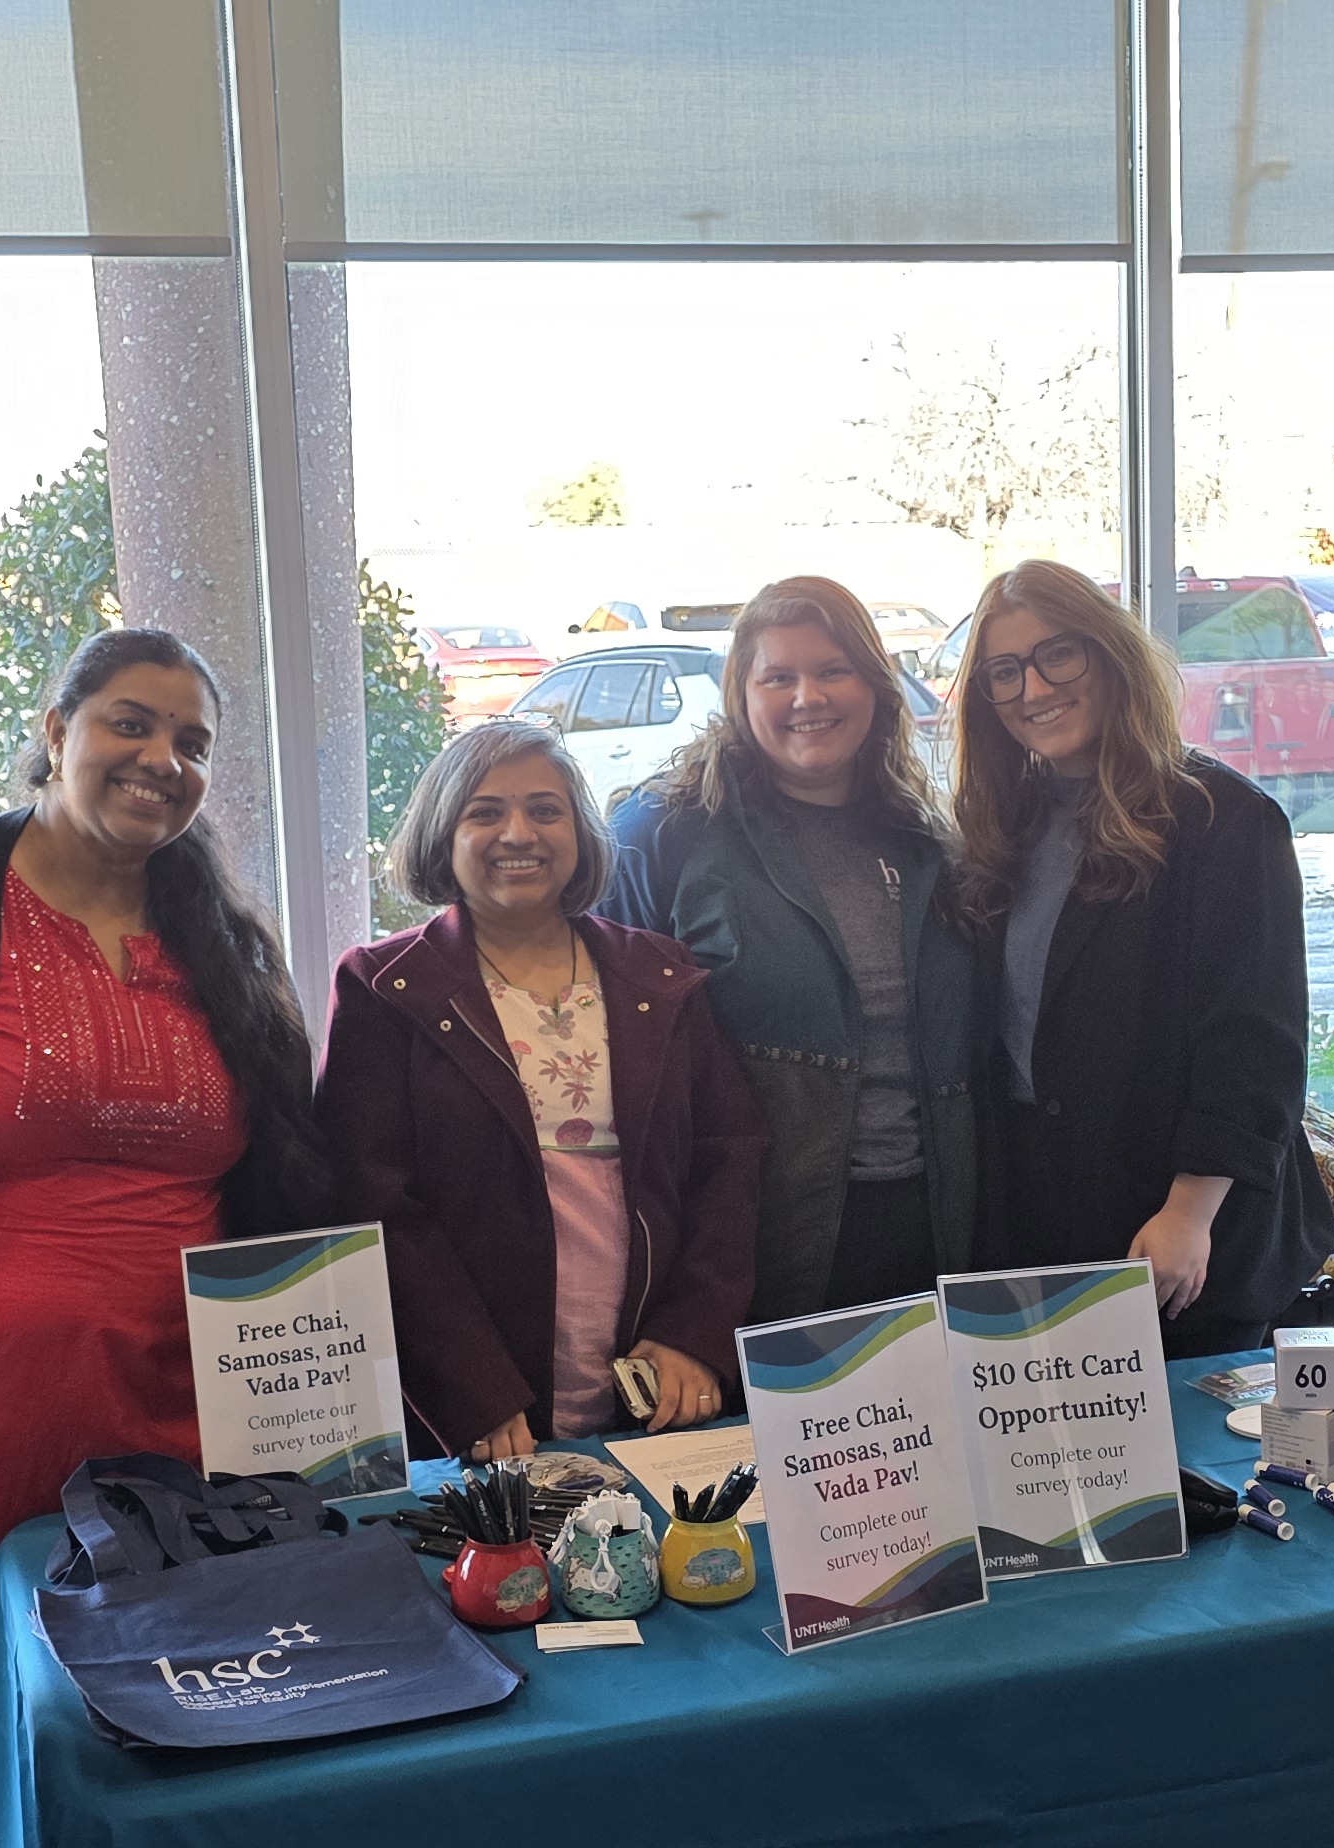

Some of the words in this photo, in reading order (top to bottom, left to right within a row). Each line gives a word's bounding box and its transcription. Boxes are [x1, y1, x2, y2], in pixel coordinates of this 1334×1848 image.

[237, 1322, 286, 1344] Free
[293, 1309, 349, 1336] Chai,
[218, 1345, 320, 1374] Samosas,
[327, 1333, 367, 1358] and
[972, 1361, 1016, 1392] $10
[1023, 1356, 1076, 1384] Gift
[1081, 1349, 1143, 1377] Card
[246, 1371, 300, 1397] Vada
[306, 1364, 351, 1389] Pav!
[1295, 1364, 1327, 1389] 60
[248, 1404, 326, 1431] Complete
[330, 1401, 357, 1419] our
[800, 1415, 851, 1441] Free
[856, 1397, 913, 1428] Chai,
[978, 1391, 1147, 1435] Opportunity!
[252, 1434, 305, 1456] survey
[310, 1425, 358, 1446] today!
[784, 1436, 887, 1478] Samosas,
[893, 1424, 933, 1455] and
[1010, 1444, 1094, 1470] Complete
[1097, 1441, 1126, 1460] our
[814, 1472, 869, 1504] Vada
[873, 1460, 920, 1490] Pav!
[1015, 1474, 1071, 1497] survey
[1076, 1469, 1129, 1493] today!
[820, 1510, 898, 1544] Complete
[901, 1504, 928, 1525] our
[826, 1546, 879, 1573] survey
[883, 1531, 932, 1559] today!
[1005, 1552, 1039, 1566] Health
[794, 1623, 817, 1638] UNT
[818, 1615, 850, 1633] Health
[152, 1649, 292, 1695] hsc
[284, 1668, 388, 1692] Implementation
[227, 1686, 266, 1698] Lab
